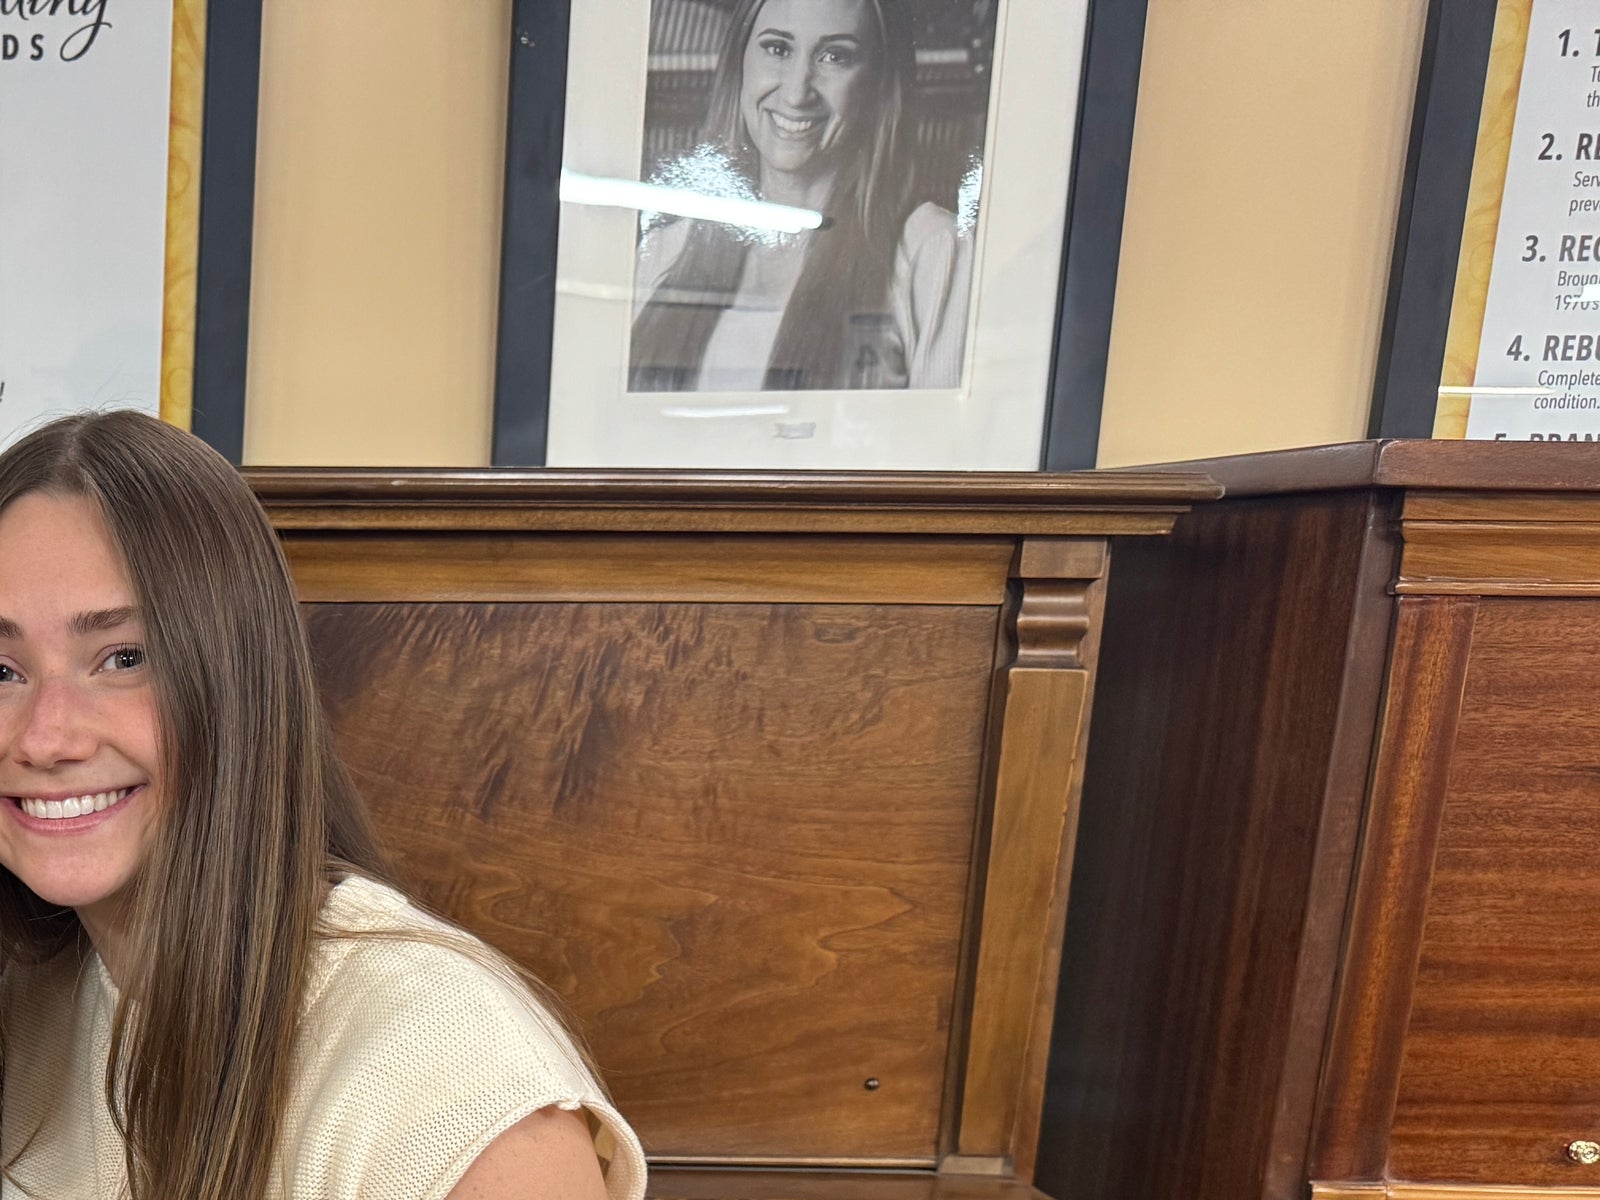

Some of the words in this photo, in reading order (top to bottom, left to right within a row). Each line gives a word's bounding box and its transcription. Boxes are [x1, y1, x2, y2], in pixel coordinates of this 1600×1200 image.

[1557, 28, 1580, 57] 1.
[1537, 132, 1563, 161] 2.
[1568, 199, 1600, 217] prev
[1521, 234, 1546, 262] 3.
[1506, 334, 1530, 362] 4.
